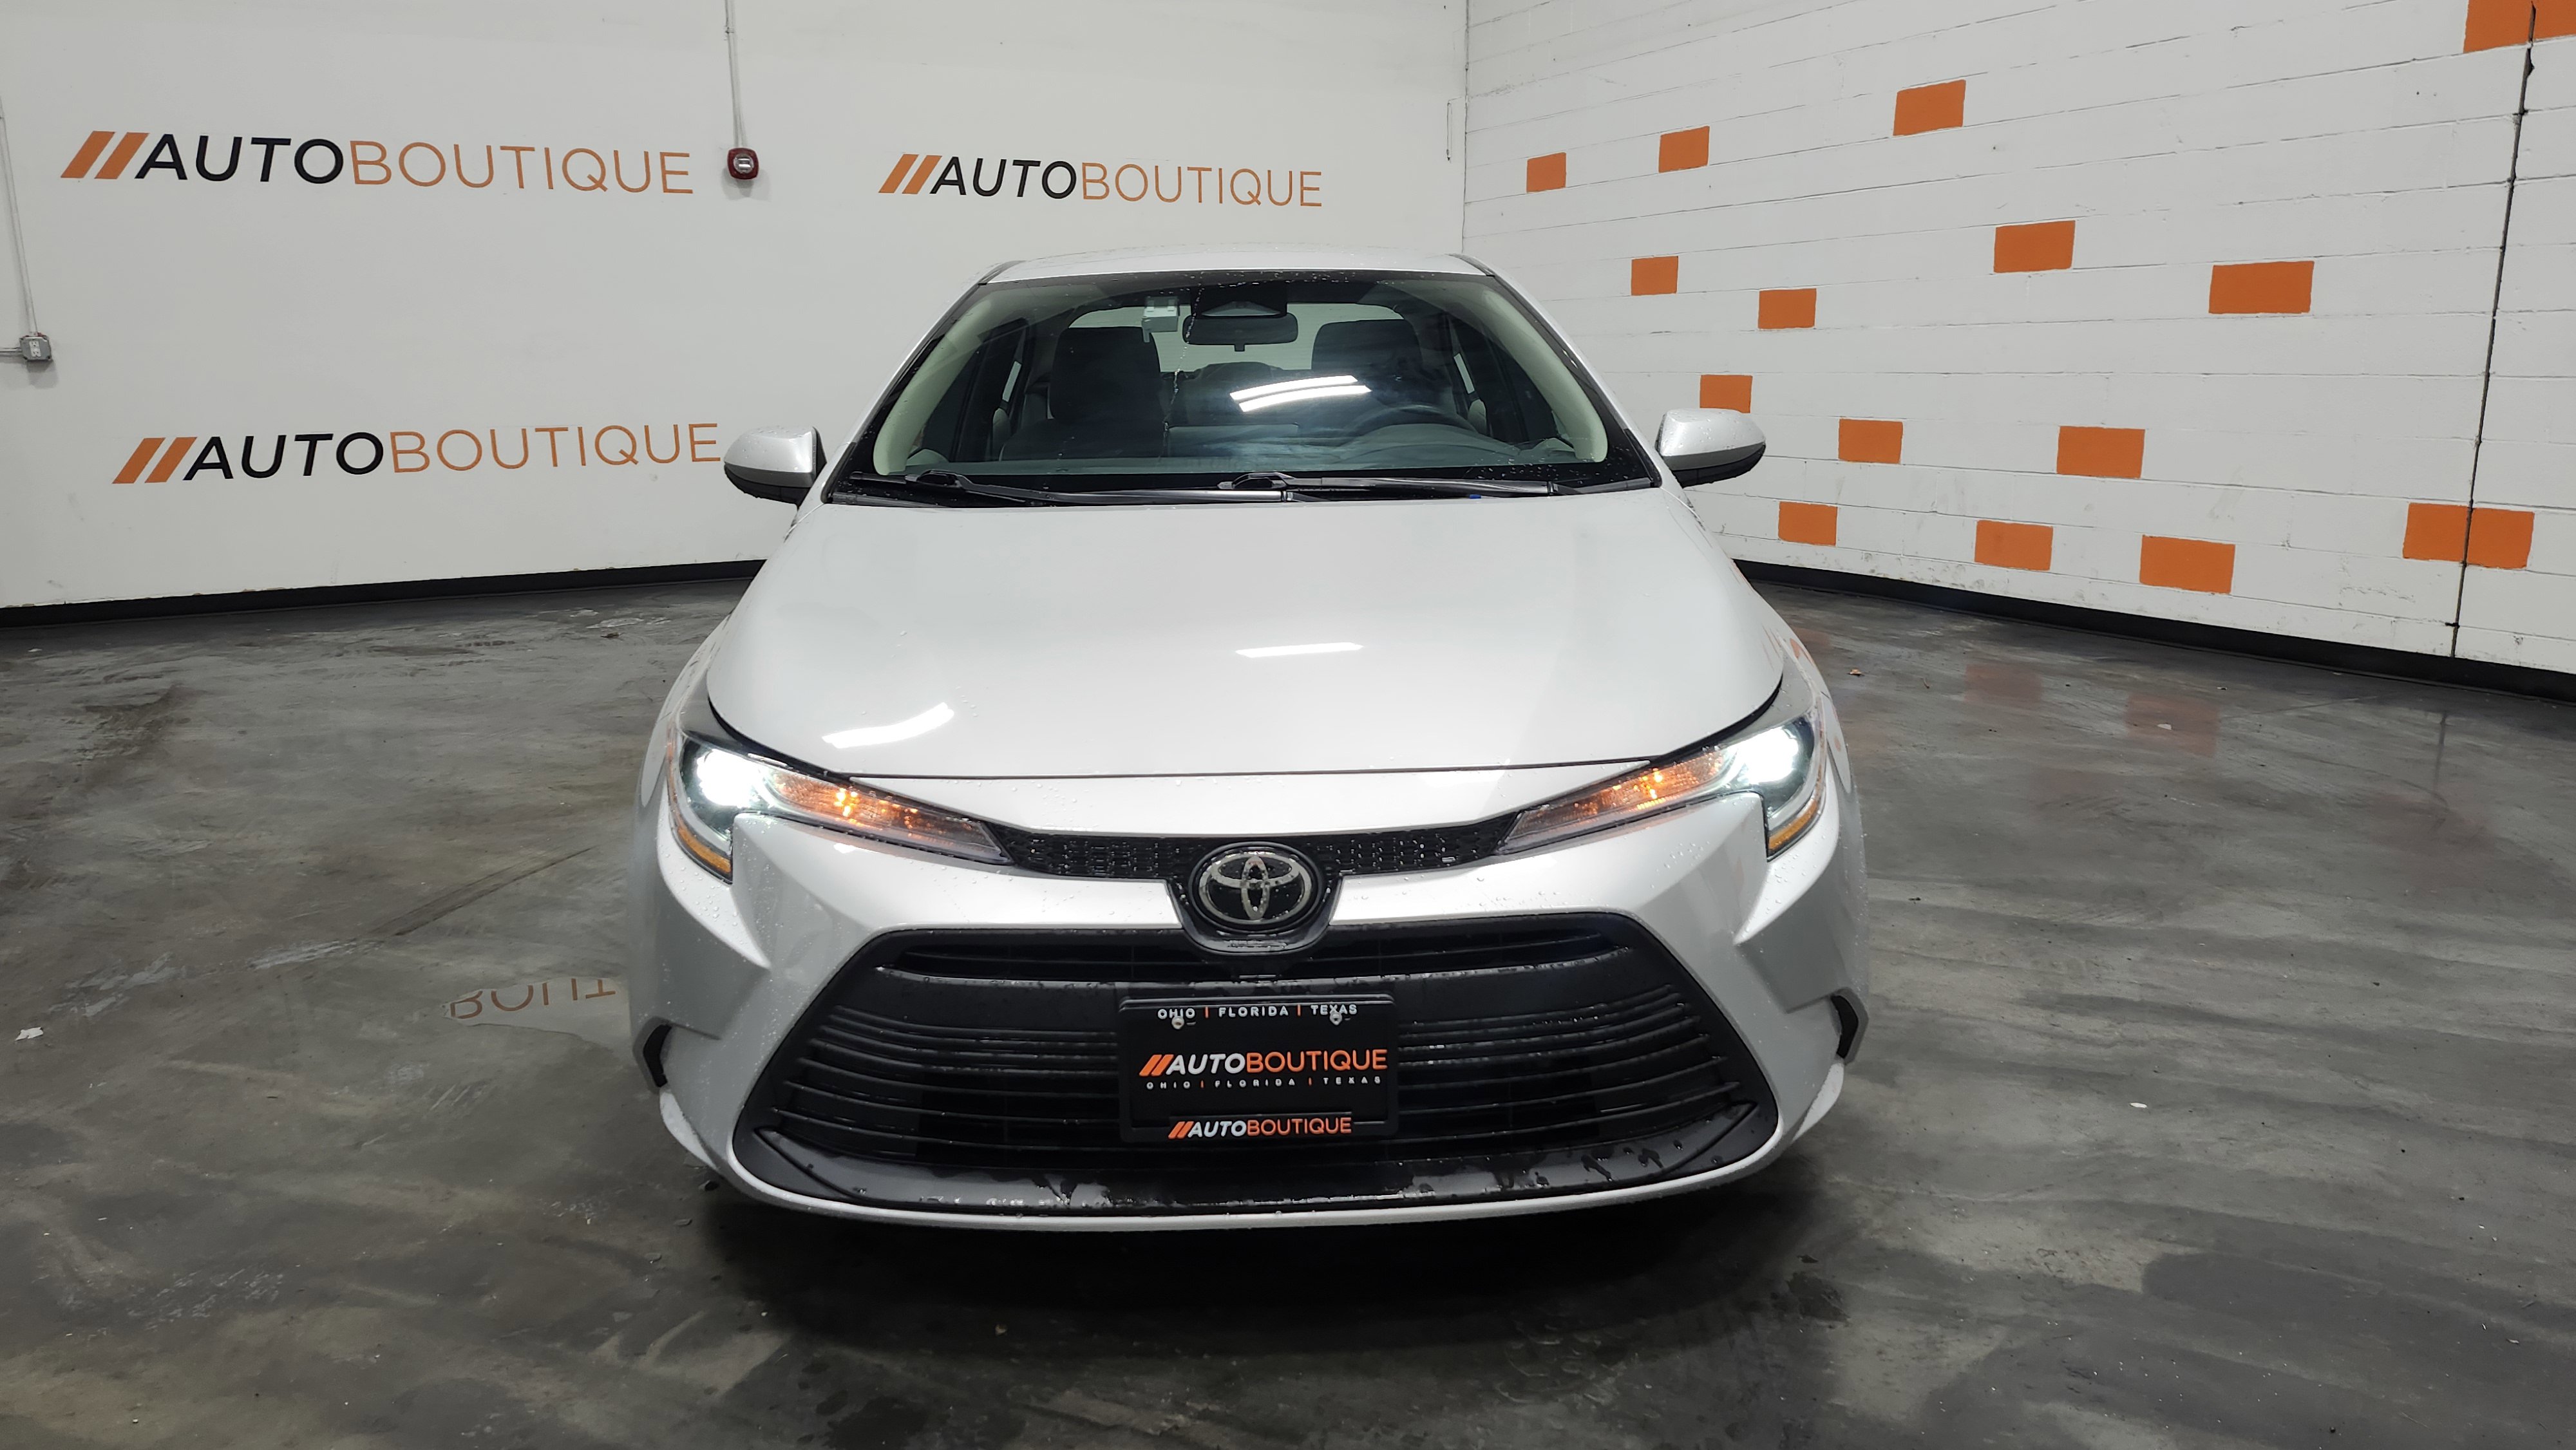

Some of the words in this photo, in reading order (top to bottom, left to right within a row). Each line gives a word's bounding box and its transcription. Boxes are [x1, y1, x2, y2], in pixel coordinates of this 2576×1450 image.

[1157, 1008, 1196, 1020] OHIO
[1218, 1005, 1289, 1017] FLORIDA
[1311, 1004, 1358, 1015] TEXAS
[1146, 1080, 1191, 1090] OHIO
[1215, 1078, 1296, 1089] FLORIDA
[1323, 1076, 1381, 1086] TEXAS
